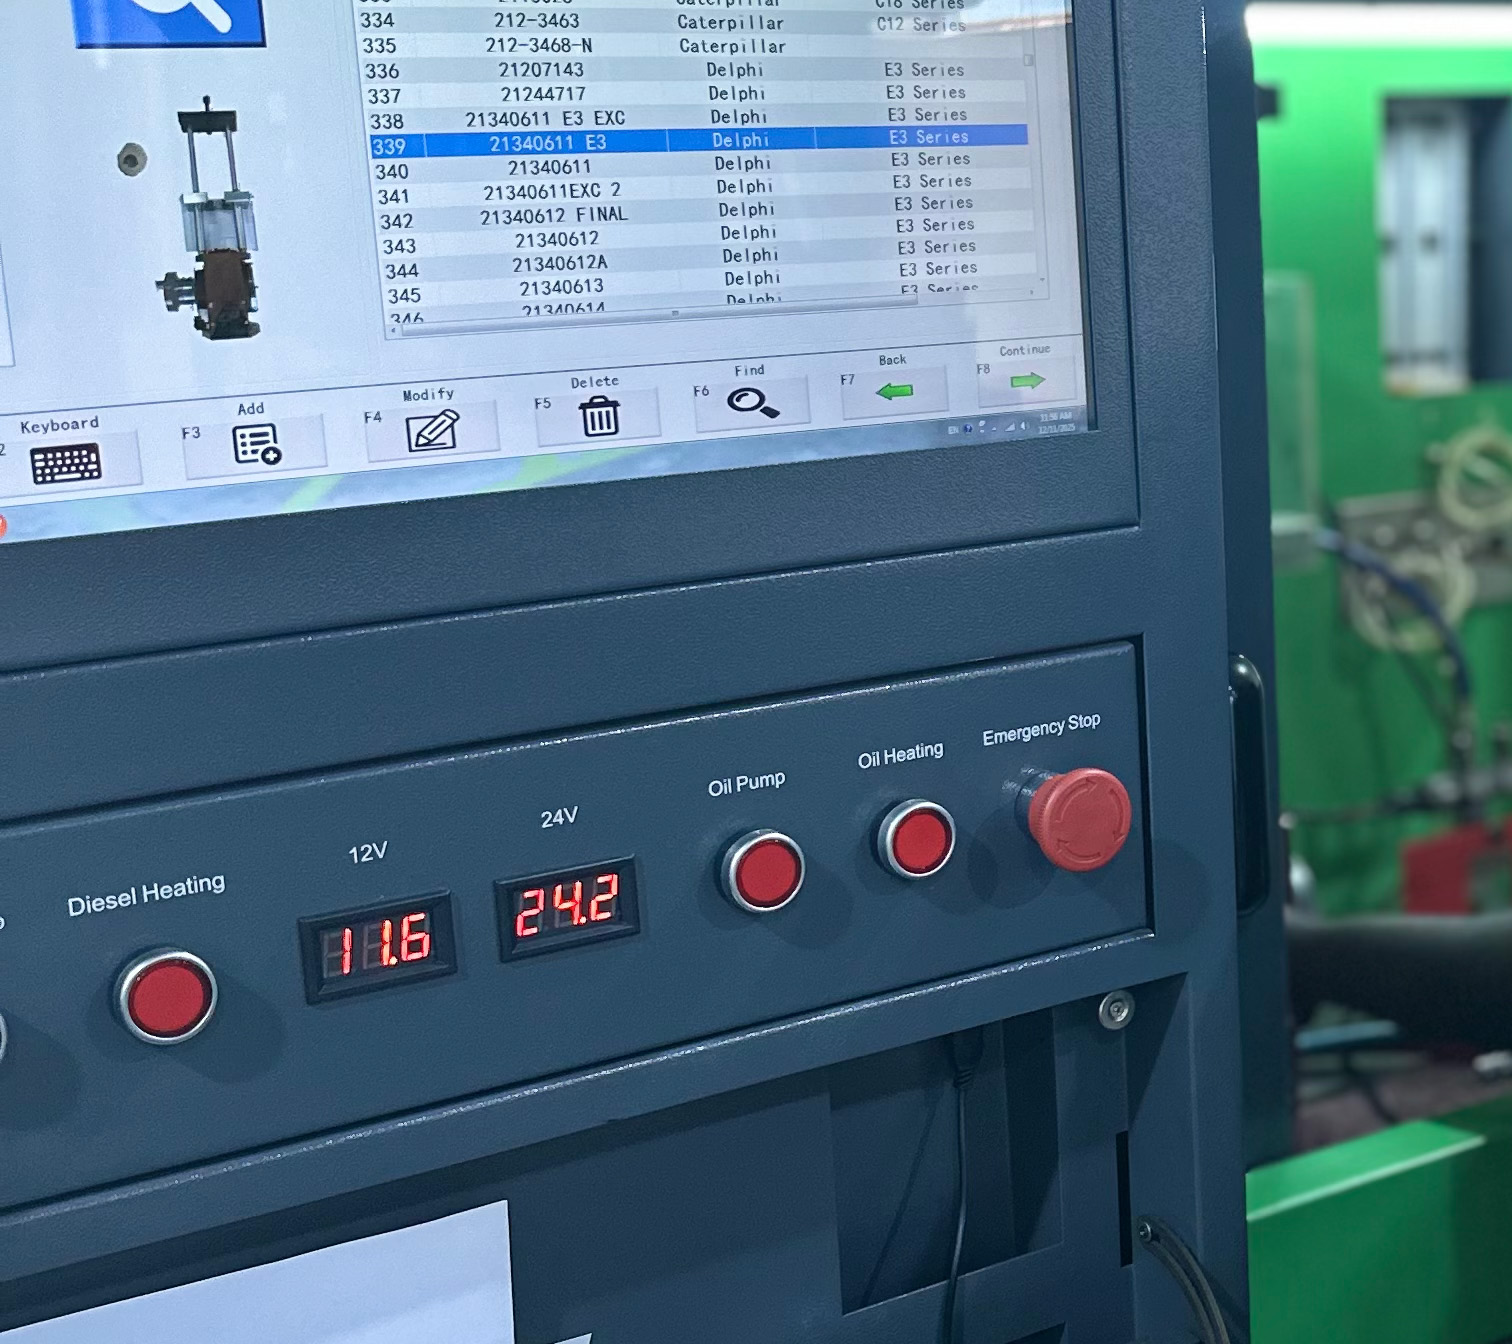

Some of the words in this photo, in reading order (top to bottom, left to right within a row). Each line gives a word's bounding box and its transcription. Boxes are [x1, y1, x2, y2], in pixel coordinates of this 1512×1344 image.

[360, 12, 395, 29] 334
[494, 12, 580, 30] 212-3463
[677, 14, 785, 32] Caterpillar
[876, 16, 905, 31] C12
[912, 17, 967, 33] Series
[362, 37, 397, 55] 335
[485, 37, 593, 53] 212-3468-N
[679, 38, 786, 56] Caterpillar
[365, 63, 400, 80] 336
[498, 61, 585, 78] 21207143
[706, 61, 764, 79] Delphi
[884, 62, 903, 77] E3
[911, 62, 965, 77] Series
[367, 88, 401, 105] 337
[501, 86, 586, 102] 21244717
[708, 84, 766, 102] Delphi
[886, 85, 905, 100] E3
[913, 84, 966, 100] Series
[370, 113, 404, 130] 338
[465, 111, 550, 128] 21340611
[562, 110, 584, 127] E3
[594, 110, 625, 126] EXC
[710, 108, 768, 126] Delphi
[888, 107, 906, 122] E3
[914, 107, 968, 122] Series
[372, 138, 406, 155] 339
[489, 135, 574, 153] 21340611
[585, 134, 607, 151] E3
[712, 131, 770, 150] Delphi
[889, 129, 908, 145] E3
[916, 129, 969, 144] Series
[375, 163, 409, 180] 340
[507, 159, 592, 176] 21340611
[715, 154, 772, 172] Delphi
[891, 151, 910, 167] E3
[918, 151, 971, 166] Series
[377, 188, 410, 205] 341
[483, 183, 602, 201] 21340611EXC
[610, 182, 621, 197] 2
[716, 178, 773, 196] Delphi
[892, 174, 911, 189] E3
[919, 173, 972, 188] Series
[380, 213, 414, 230] 342
[480, 208, 566, 226] 21340612
[576, 207, 629, 223] FINAL
[718, 201, 775, 218] Delphi
[894, 196, 913, 211] E3
[921, 195, 974, 210] Series
[382, 238, 417, 255] 343
[515, 230, 600, 249] 21340612
[720, 224, 777, 242] Delphi
[896, 218, 914, 234] E3
[922, 218, 975, 233] Series
[385, 262, 419, 280] 344
[512, 255, 608, 273] 21340612A
[722, 247, 779, 265] Delphi
[897, 240, 916, 255] E3
[924, 239, 976, 254] Series
[387, 287, 422, 304] 345
[519, 278, 604, 297] 21340613
[724, 271, 781, 288] Delphi
[899, 262, 917, 277] E3
[926, 261, 978, 276] Series
[878, 353, 907, 367] Back
[999, 343, 1051, 358] Continue
[734, 363, 765, 377] Find
[976, 362, 991, 376] F8
[570, 374, 619, 390] Delete
[840, 373, 855, 387] F7
[402, 387, 455, 404] Modify
[693, 384, 710, 399] F6
[237, 401, 265, 417] Add
[534, 396, 552, 411] F5
[20, 415, 100, 434] Keyboard
[363, 409, 382, 425] F4
[1059, 411, 1073, 420] AM
[181, 426, 201, 441] F3
[948, 426, 959, 435] EN
[982, 718, 1066, 746] Emergency
[1068, 712, 1102, 734] Stop
[857, 750, 881, 769] Oil
[883, 740, 945, 766] Heating
[708, 777, 733, 797] Oil
[736, 770, 787, 795] Pump
[540, 805, 580, 829] 24V
[348, 840, 389, 865] 12V
[67, 886, 138, 917] Diesel
[142, 872, 226, 904] Heating
[515, 873, 619, 937] 24.2
[340, 912, 430, 975] 11.6
